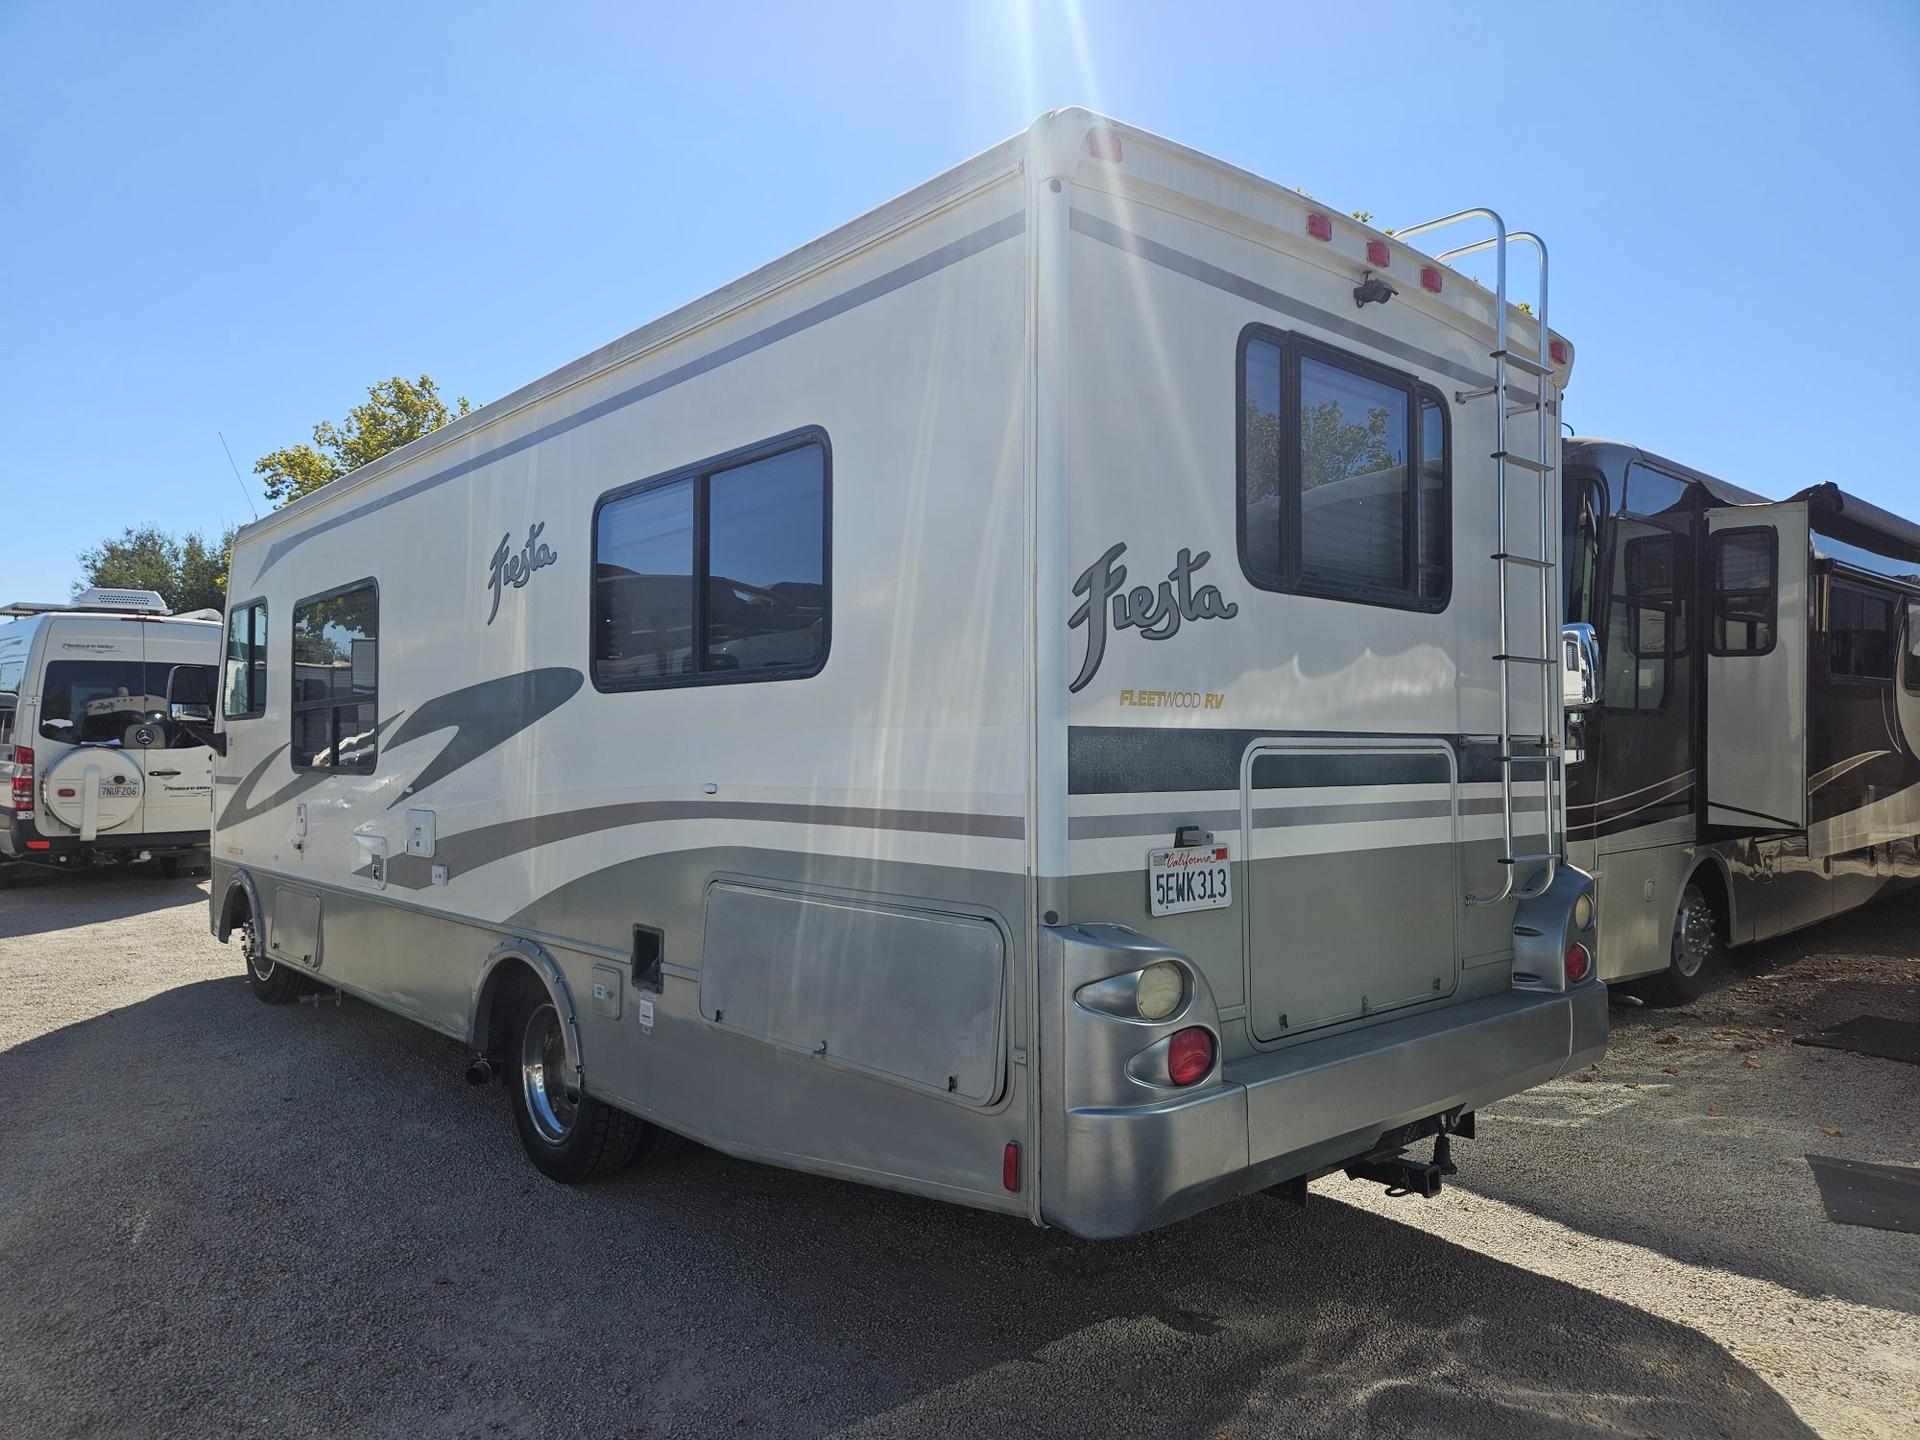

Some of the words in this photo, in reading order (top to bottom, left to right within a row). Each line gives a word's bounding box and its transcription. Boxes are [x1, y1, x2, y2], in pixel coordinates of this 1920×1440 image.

[487, 521, 557, 626] Fiesta
[1068, 541, 1239, 694] Fiesta
[1119, 689, 1201, 708] FLEETWOOD
[1204, 693, 1225, 709] RV
[1167, 852, 1216, 870] California
[1156, 868, 1227, 905] 5EWK313
